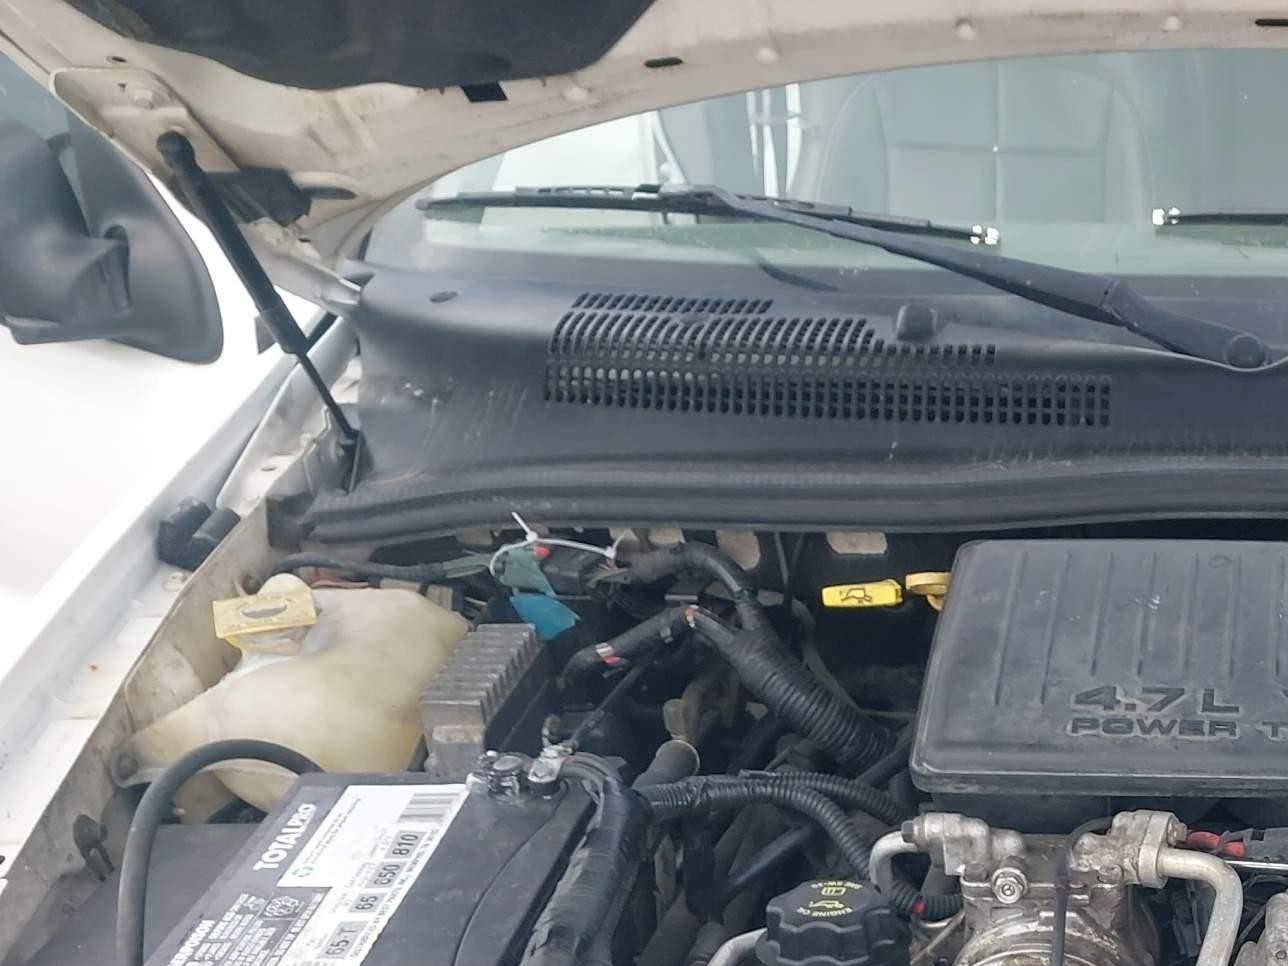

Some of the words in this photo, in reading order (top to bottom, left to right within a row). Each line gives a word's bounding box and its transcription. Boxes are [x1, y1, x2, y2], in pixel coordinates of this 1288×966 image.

[1070, 717, 1238, 739] POWER
[253, 803, 318, 871] TOTALPRO
[392, 833, 418, 856] 810
[355, 895, 378, 911] 65
